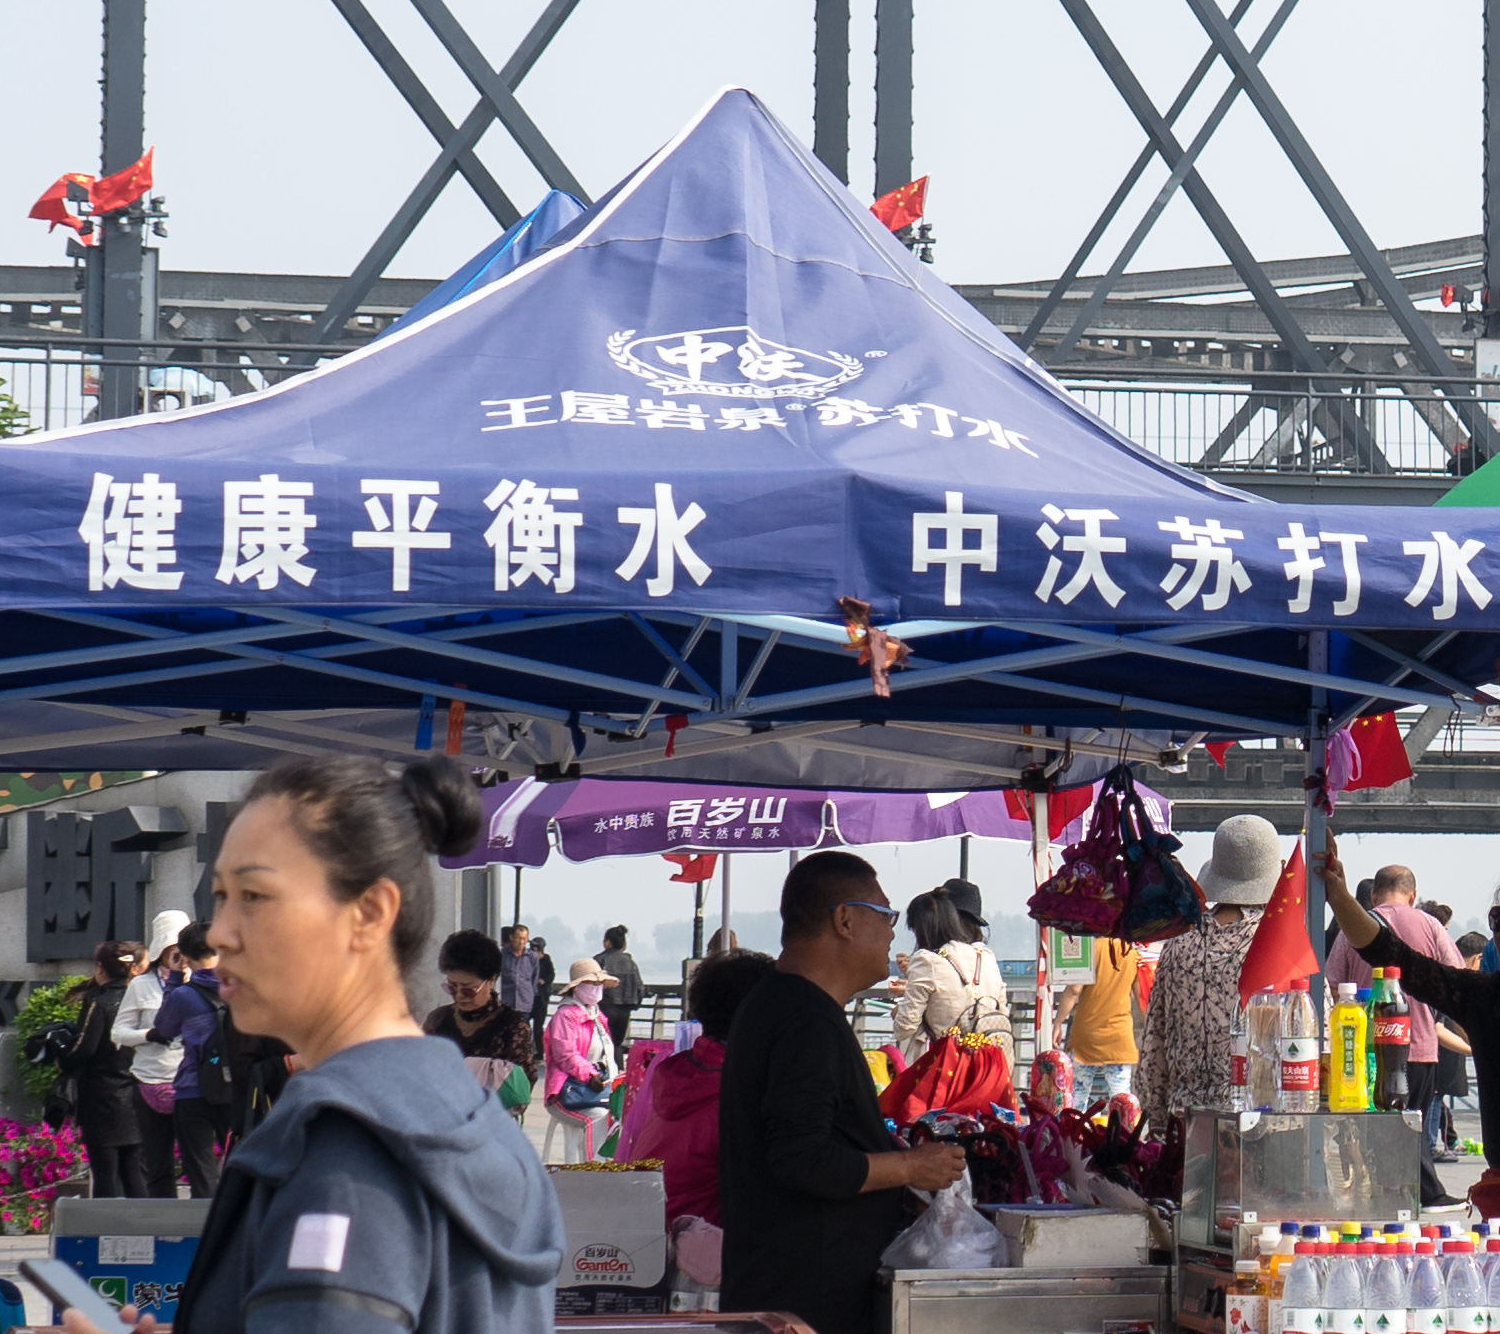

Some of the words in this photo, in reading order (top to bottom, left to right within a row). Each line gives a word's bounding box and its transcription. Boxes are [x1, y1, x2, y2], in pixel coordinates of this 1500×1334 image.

[655, 334, 804, 384] 中沃
[480, 389, 787, 433] 王屋岩泉
[815, 396, 1039, 459] 苏打水
[77, 472, 712, 597] 健康平衡水
[912, 490, 1494, 621] 中沃苏打水
[593, 811, 655, 834] 水中贵族
[666, 797, 788, 827] 百岁山
[585, 1247, 619, 1258] 百岁山
